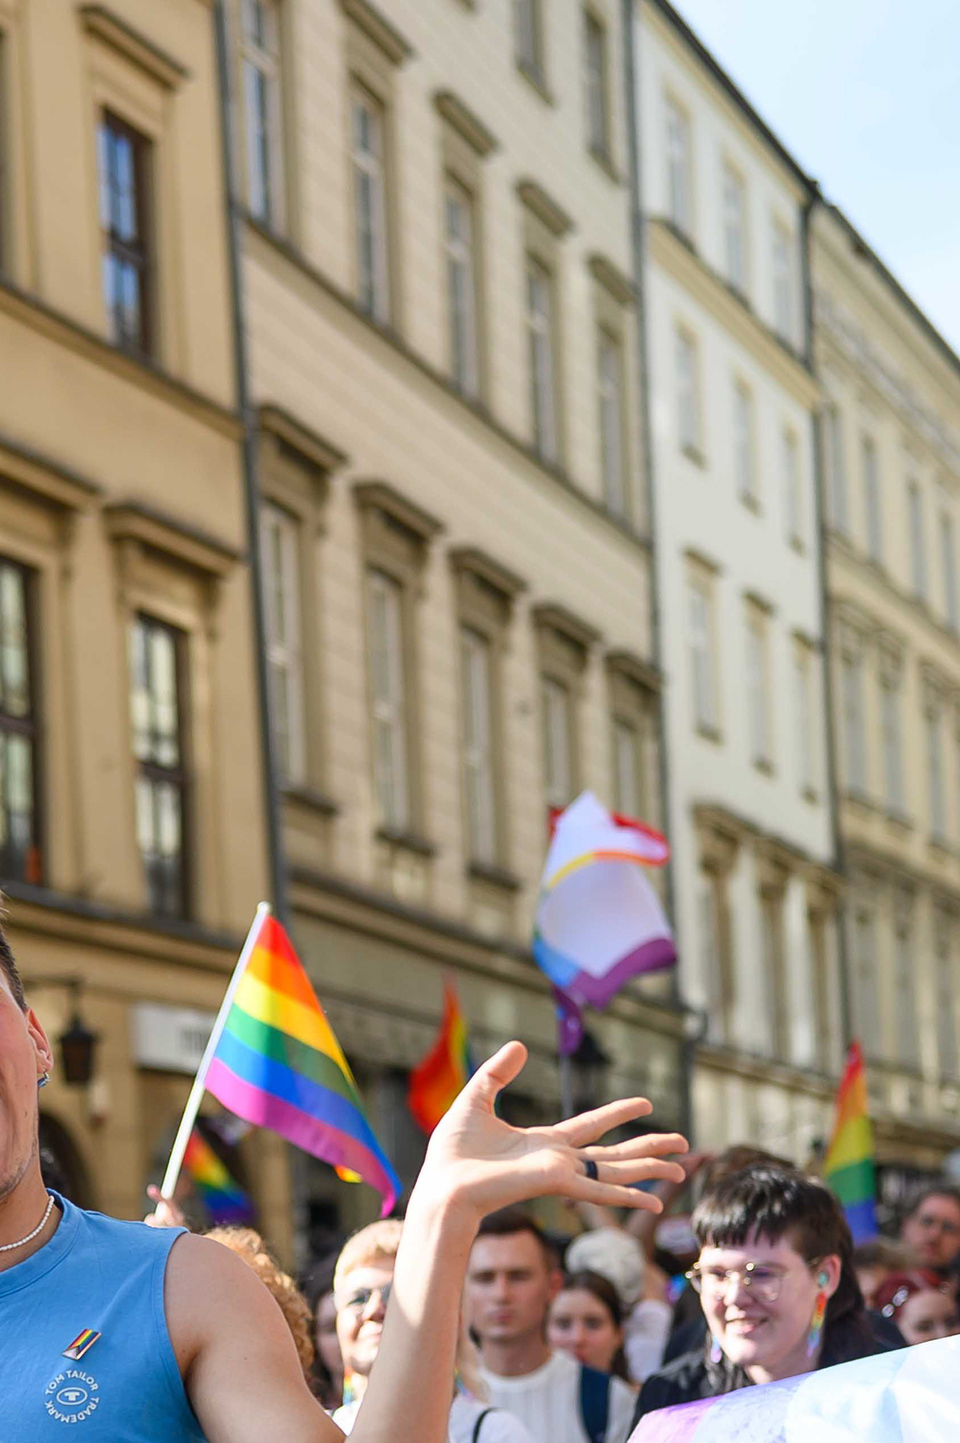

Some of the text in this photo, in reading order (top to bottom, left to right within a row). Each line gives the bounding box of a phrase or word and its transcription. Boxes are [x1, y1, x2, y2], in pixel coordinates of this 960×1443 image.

[45, 1370, 99, 1395] TOM TAILOR
[45, 1397, 99, 1423] TRADEMARK
